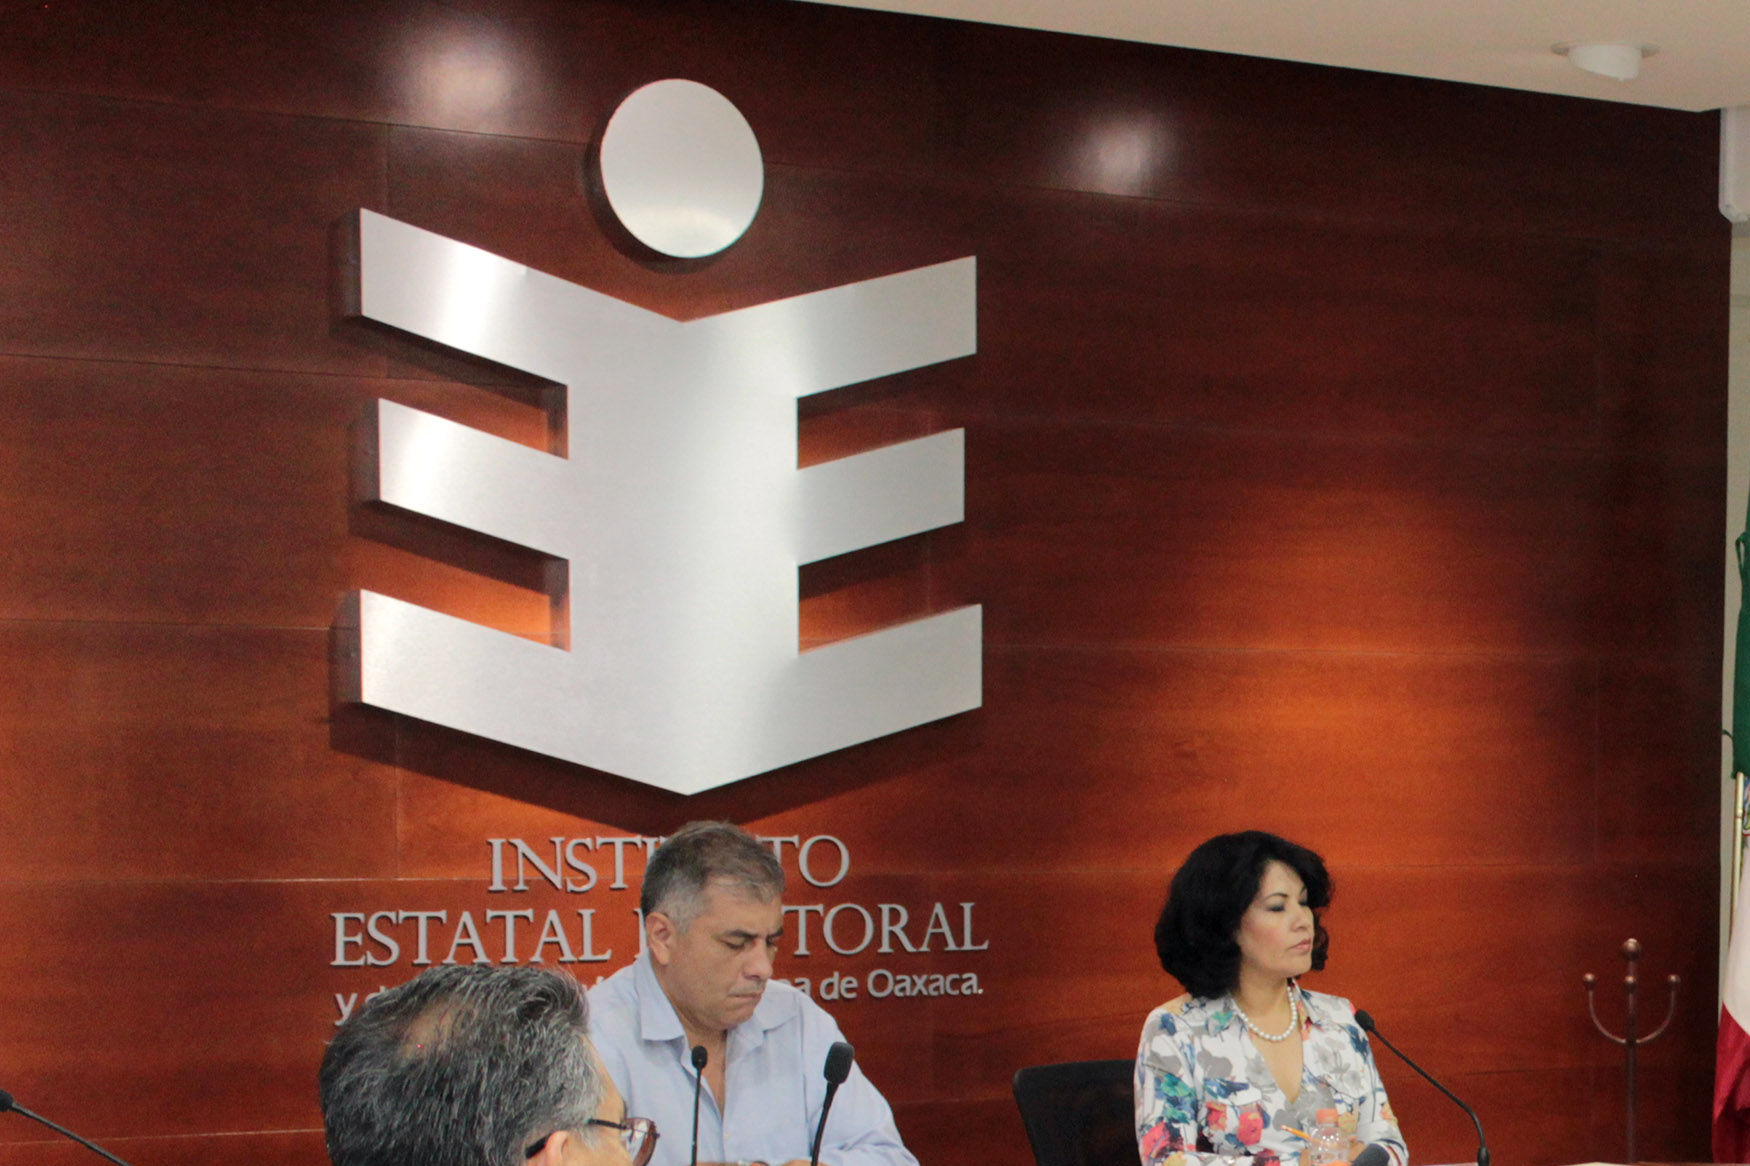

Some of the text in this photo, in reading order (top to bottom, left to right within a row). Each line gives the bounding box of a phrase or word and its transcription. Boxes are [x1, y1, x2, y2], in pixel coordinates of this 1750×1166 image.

[486, 834, 851, 893] INSTTO
[330, 908, 612, 967] ESTATAL
[819, 972, 859, 1000] de
[867, 969, 984, 998] Oaxaca.
